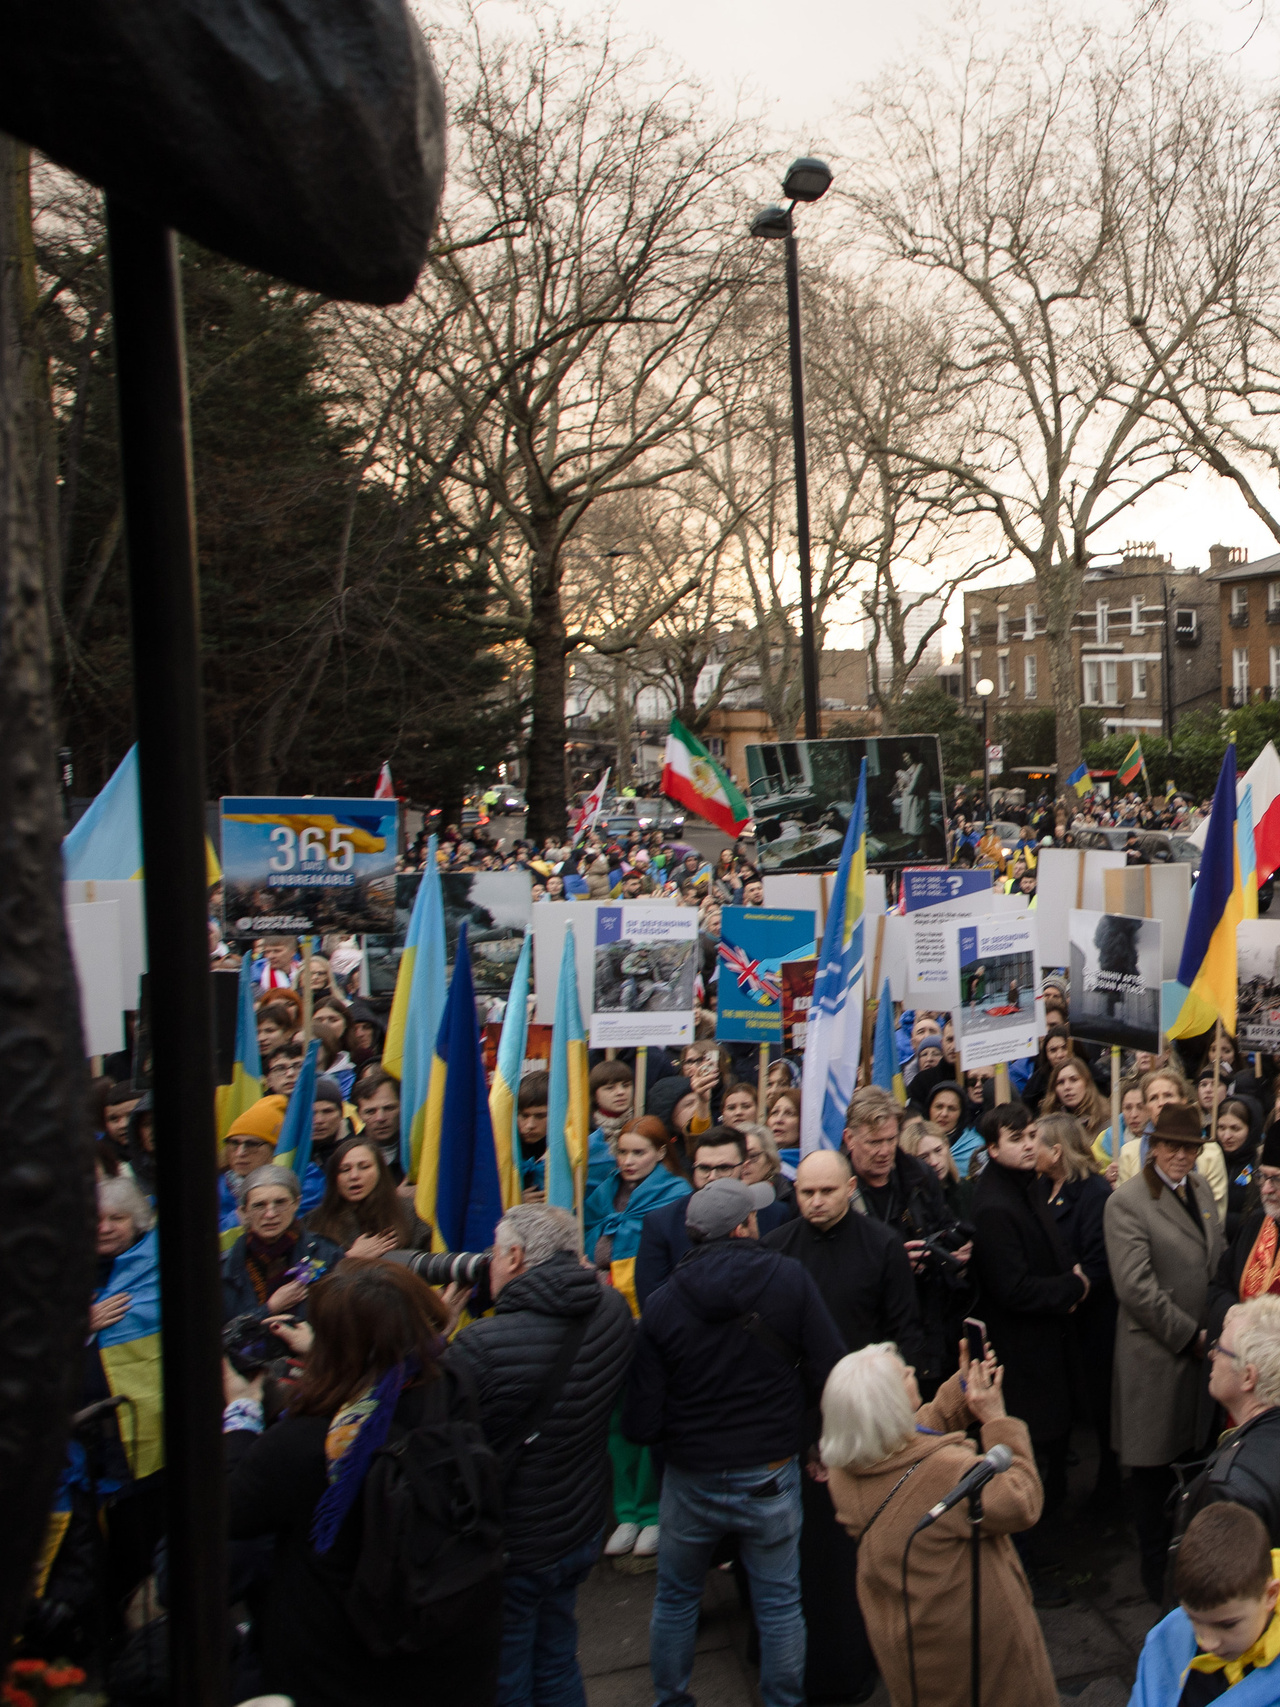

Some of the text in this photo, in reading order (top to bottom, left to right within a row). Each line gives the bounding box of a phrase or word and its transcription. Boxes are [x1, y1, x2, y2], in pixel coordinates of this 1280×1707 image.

[269, 826, 356, 872] 365
[268, 874, 356, 887] UNBREAKABLE
[946, 875, 964, 896] ?
[640, 919, 692, 929] DEFENDING
[625, 927, 670, 936] FREEDOM
[1250, 1026, 1275, 1035] AFTER
